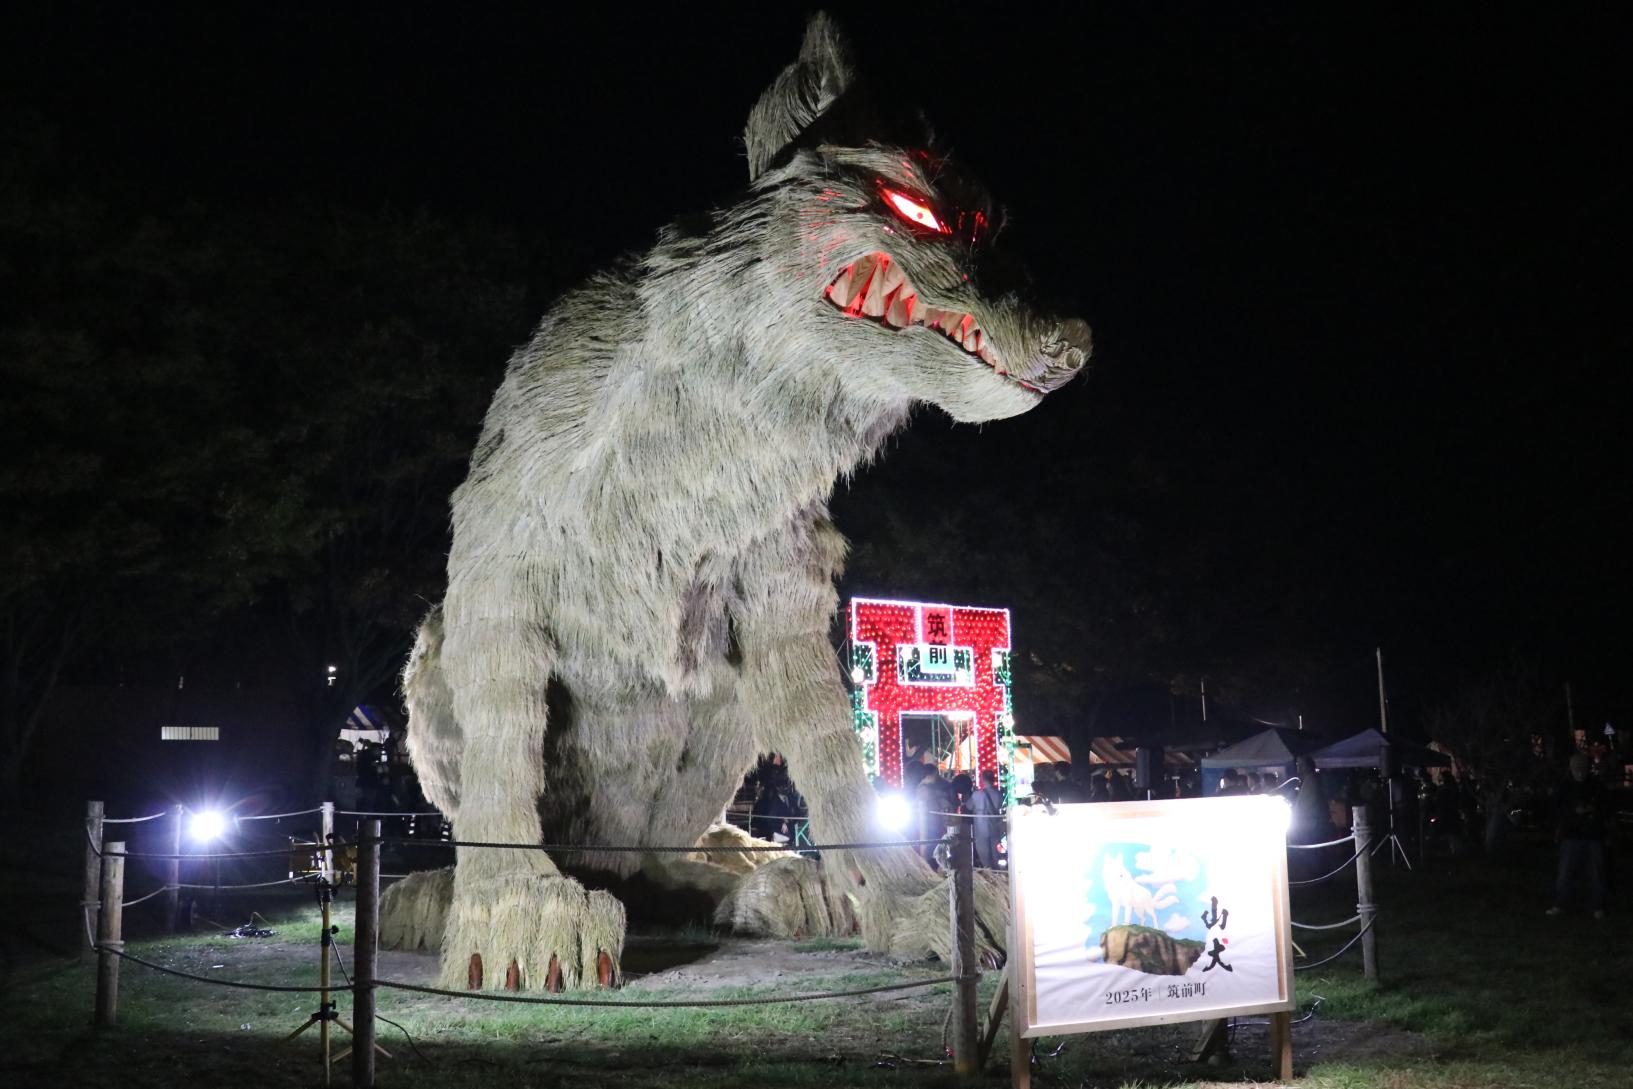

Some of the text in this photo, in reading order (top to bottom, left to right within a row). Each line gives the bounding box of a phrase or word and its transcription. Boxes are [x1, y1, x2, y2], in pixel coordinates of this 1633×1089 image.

[927, 613, 948, 665] 筑前
[1201, 896, 1233, 973] 山犬
[1105, 982, 1207, 1005] 2025年 筑前町
